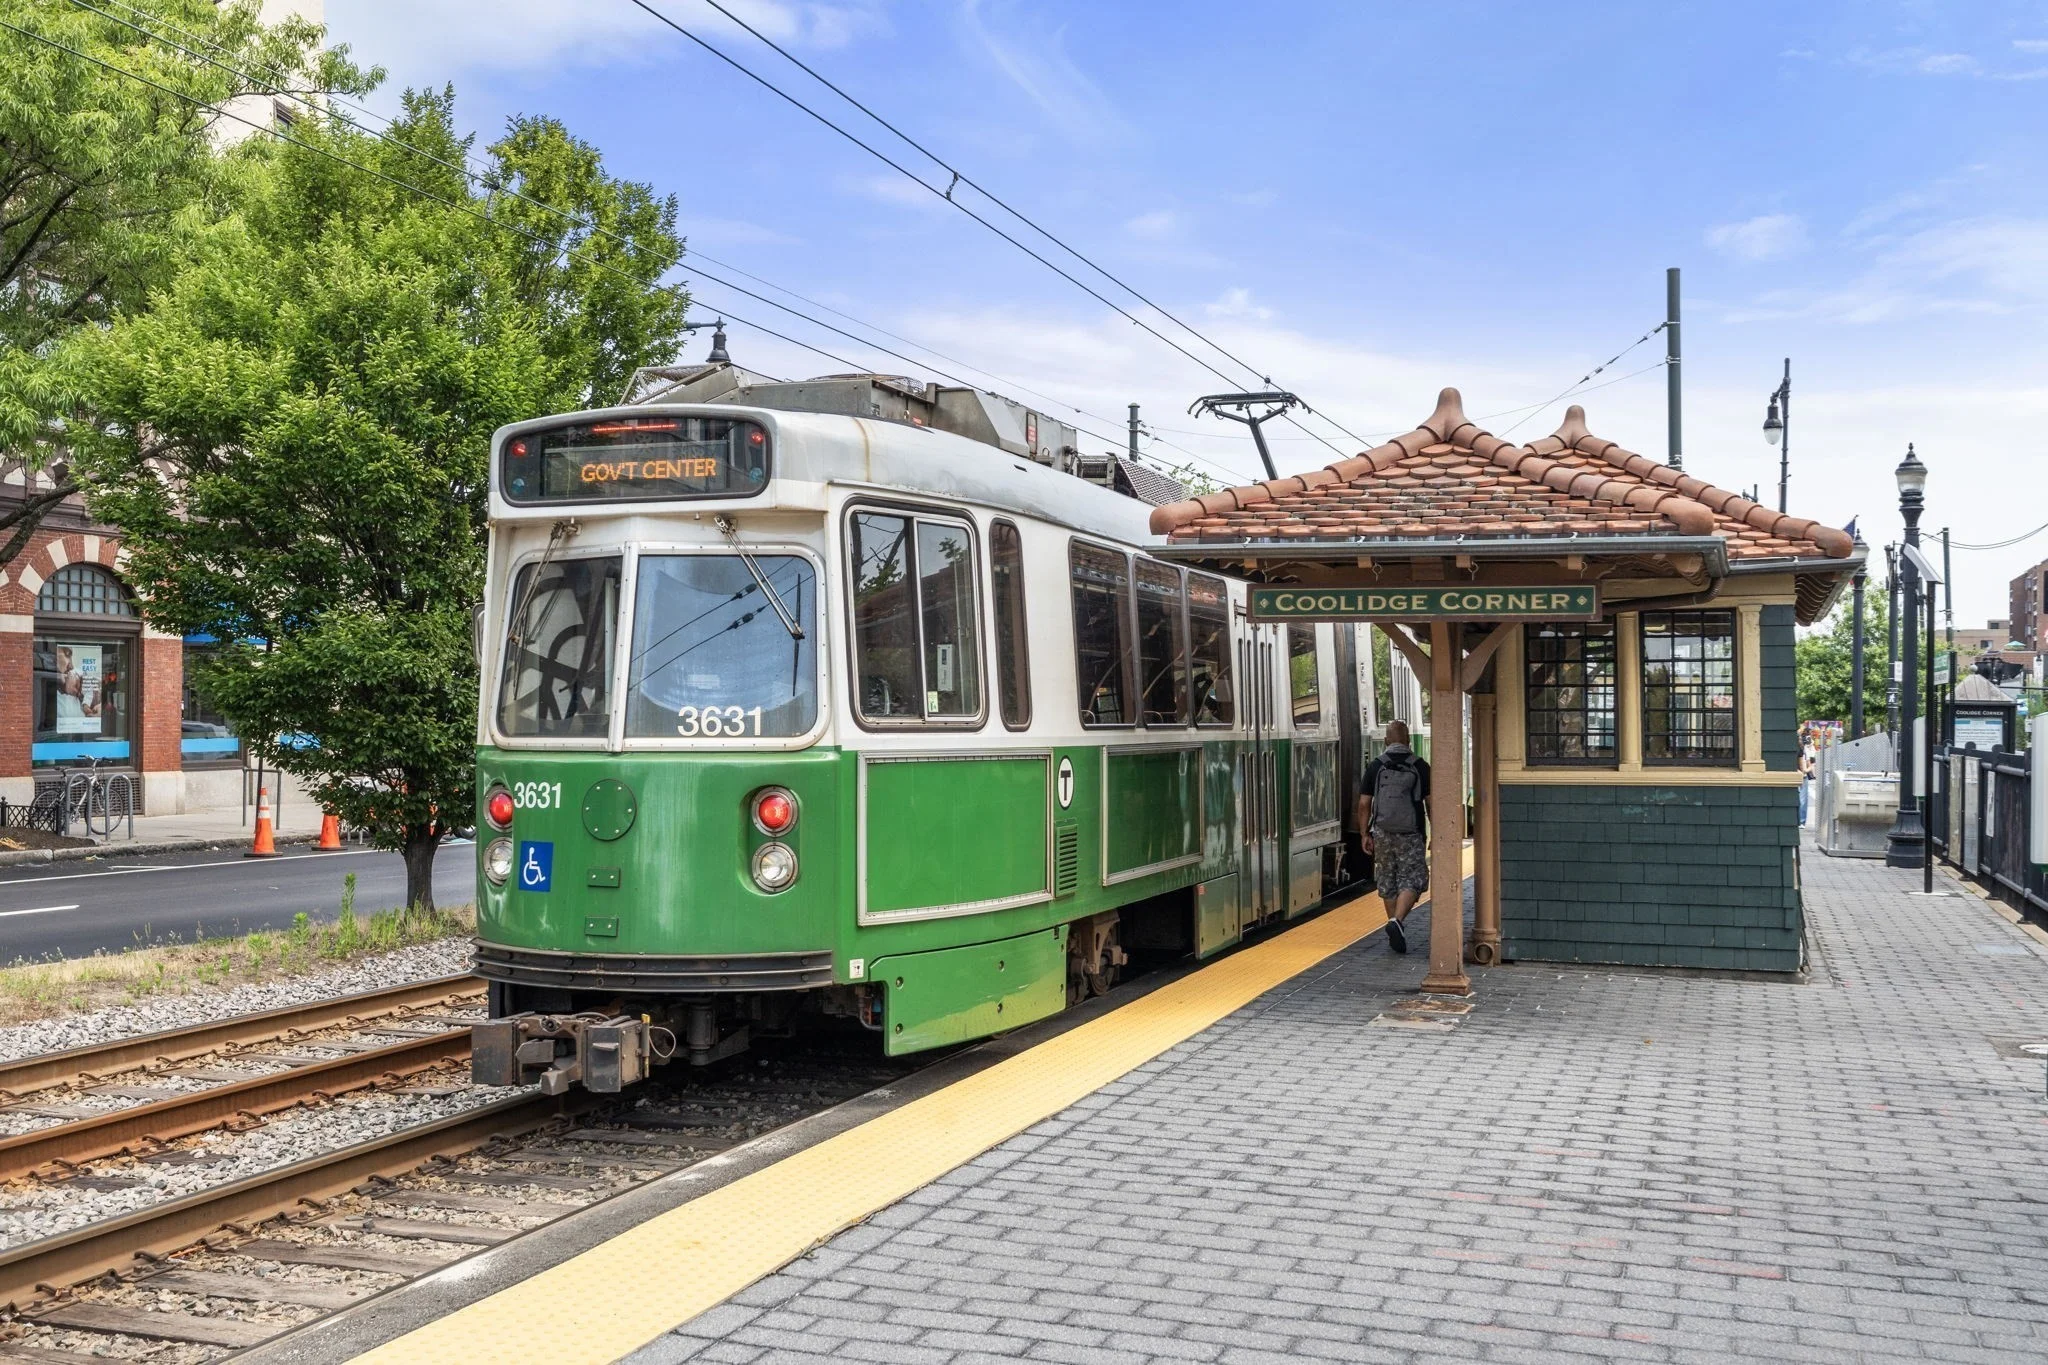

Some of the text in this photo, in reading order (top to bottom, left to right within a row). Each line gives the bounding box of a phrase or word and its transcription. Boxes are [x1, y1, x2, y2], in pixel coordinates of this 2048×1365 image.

[581, 458, 716, 481] GOV'T CENTER
[1275, 592, 1571, 612] COOLIDGE CORNER
[677, 705, 762, 737] 3631
[513, 782, 562, 809] 3631
[1060, 769, 1072, 801] T
